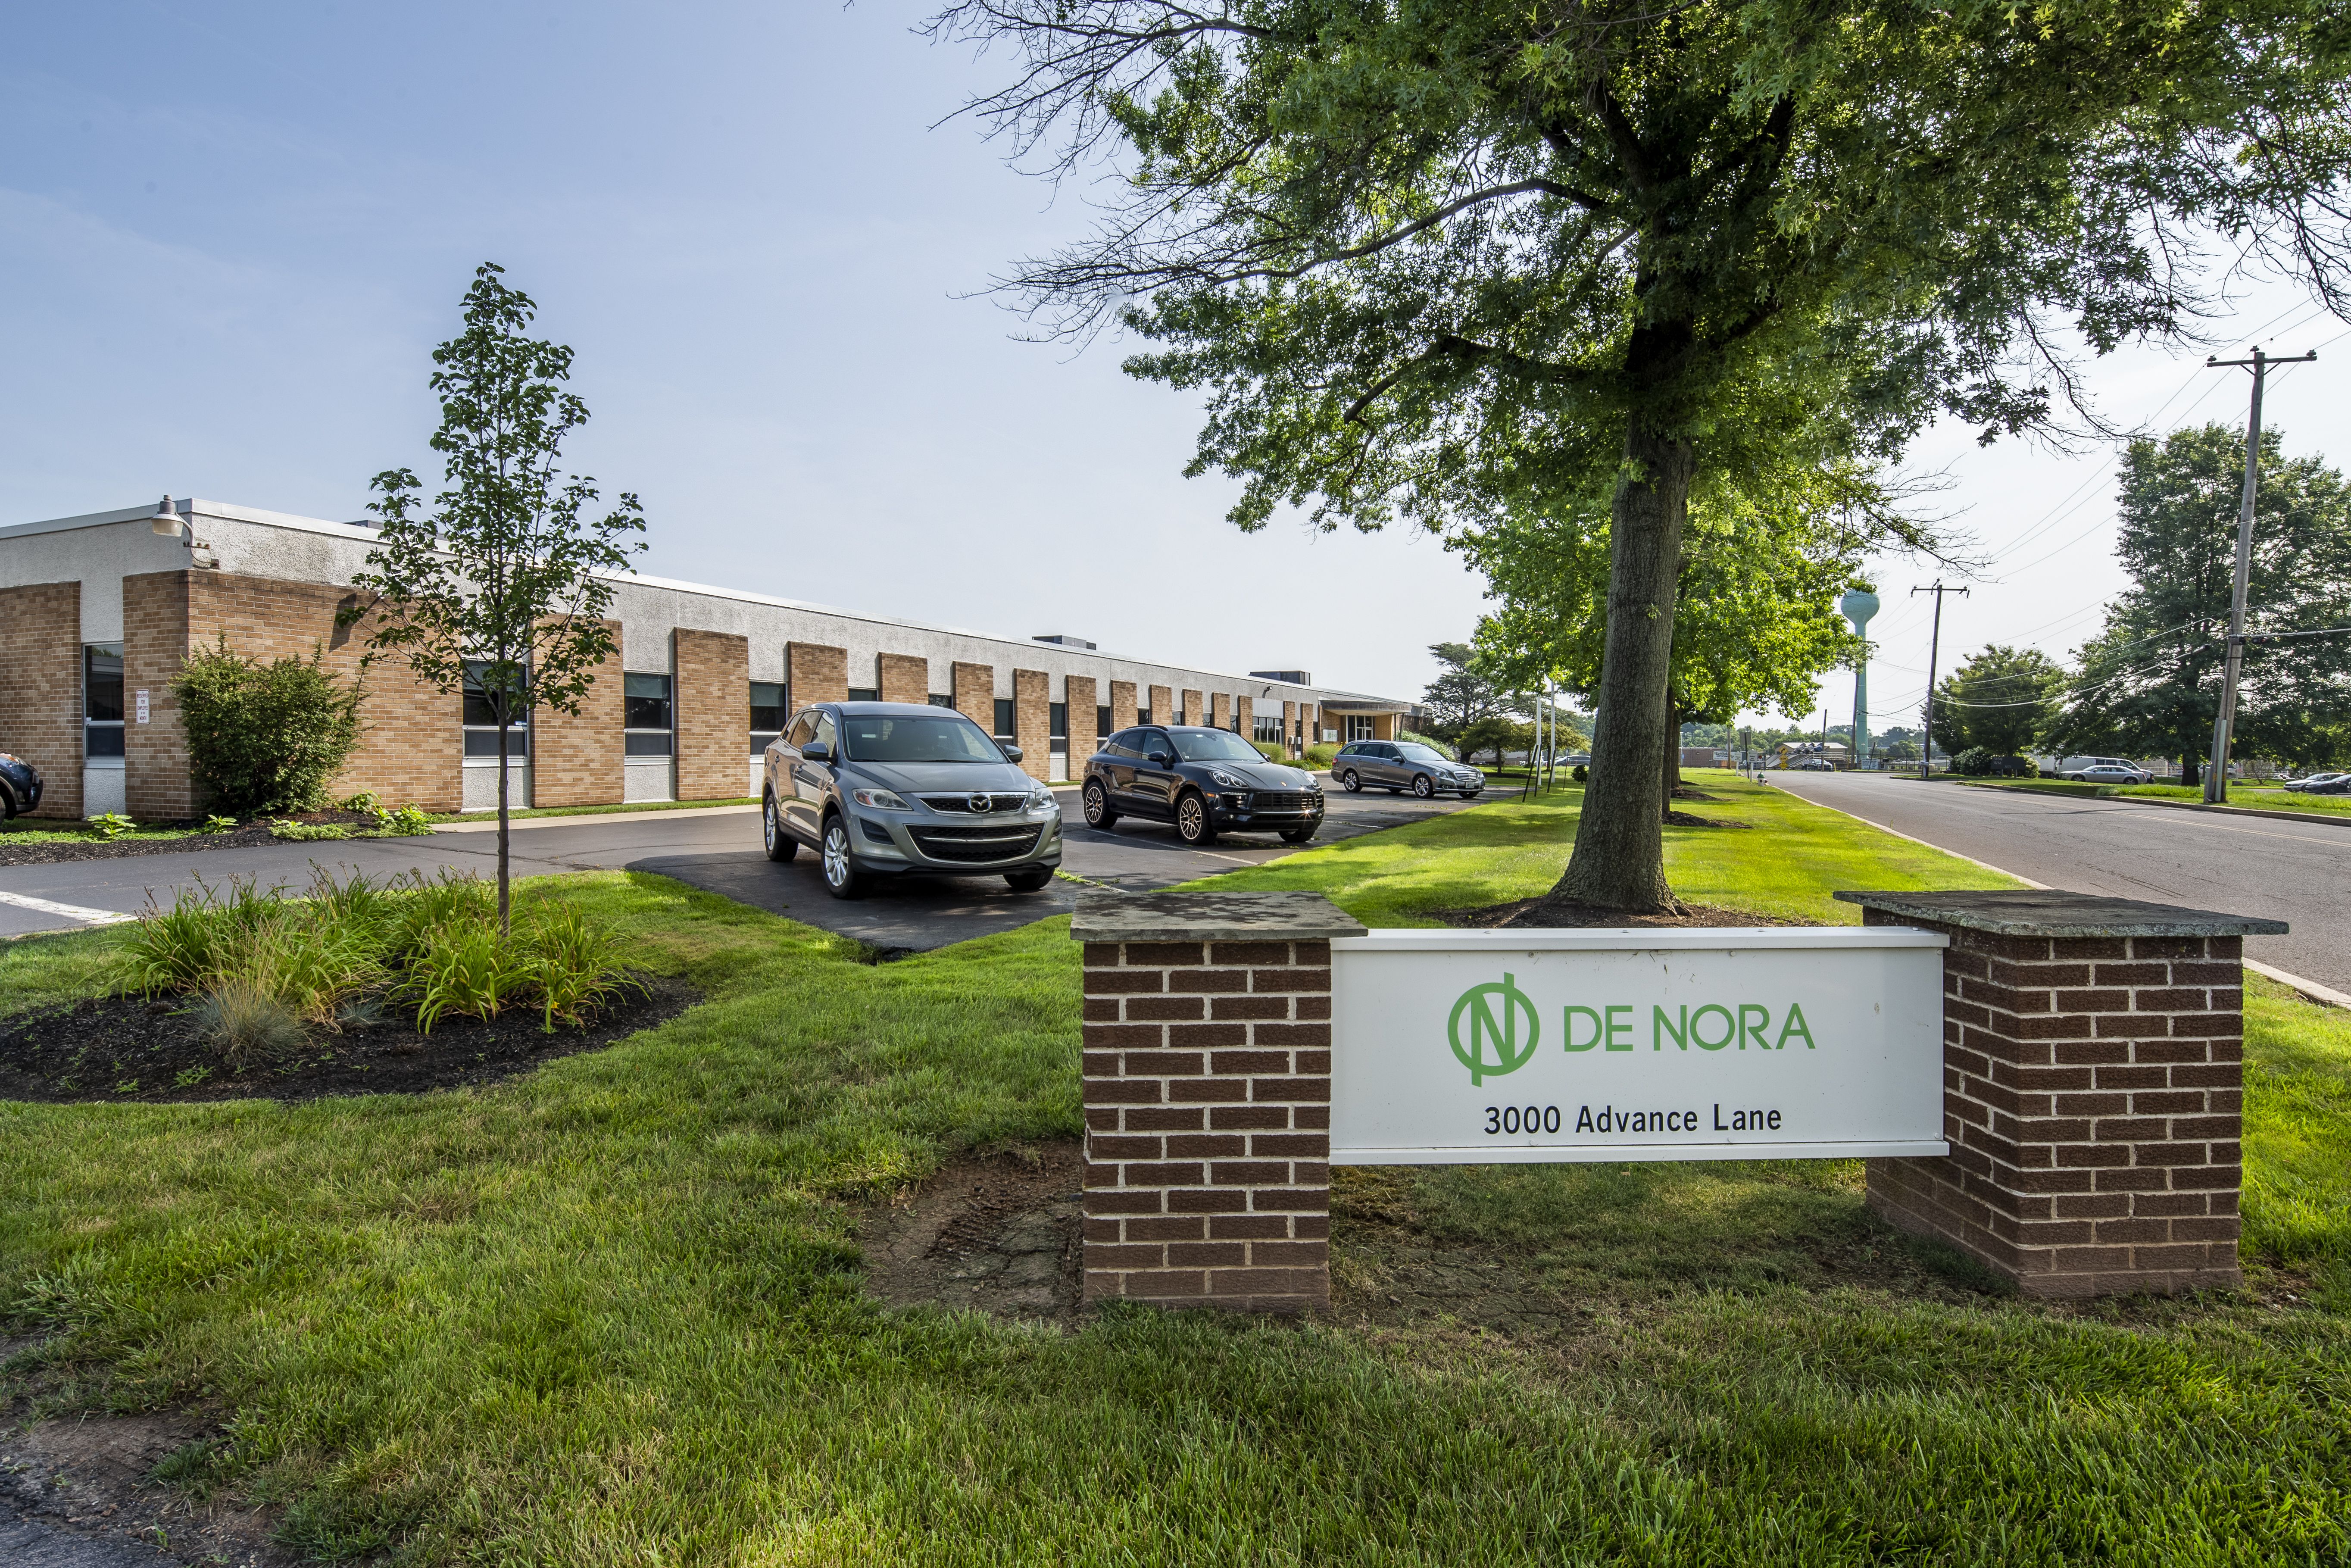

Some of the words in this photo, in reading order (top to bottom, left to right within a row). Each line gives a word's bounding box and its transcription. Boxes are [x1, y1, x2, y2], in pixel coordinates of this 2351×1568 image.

[1564, 1006, 1633, 1052] DE
[1653, 1003, 1815, 1051] NORA
[1484, 1106, 1561, 1135] 3000
[1575, 1105, 1698, 1133] Advance
[1714, 1103, 1781, 1131] Lane
